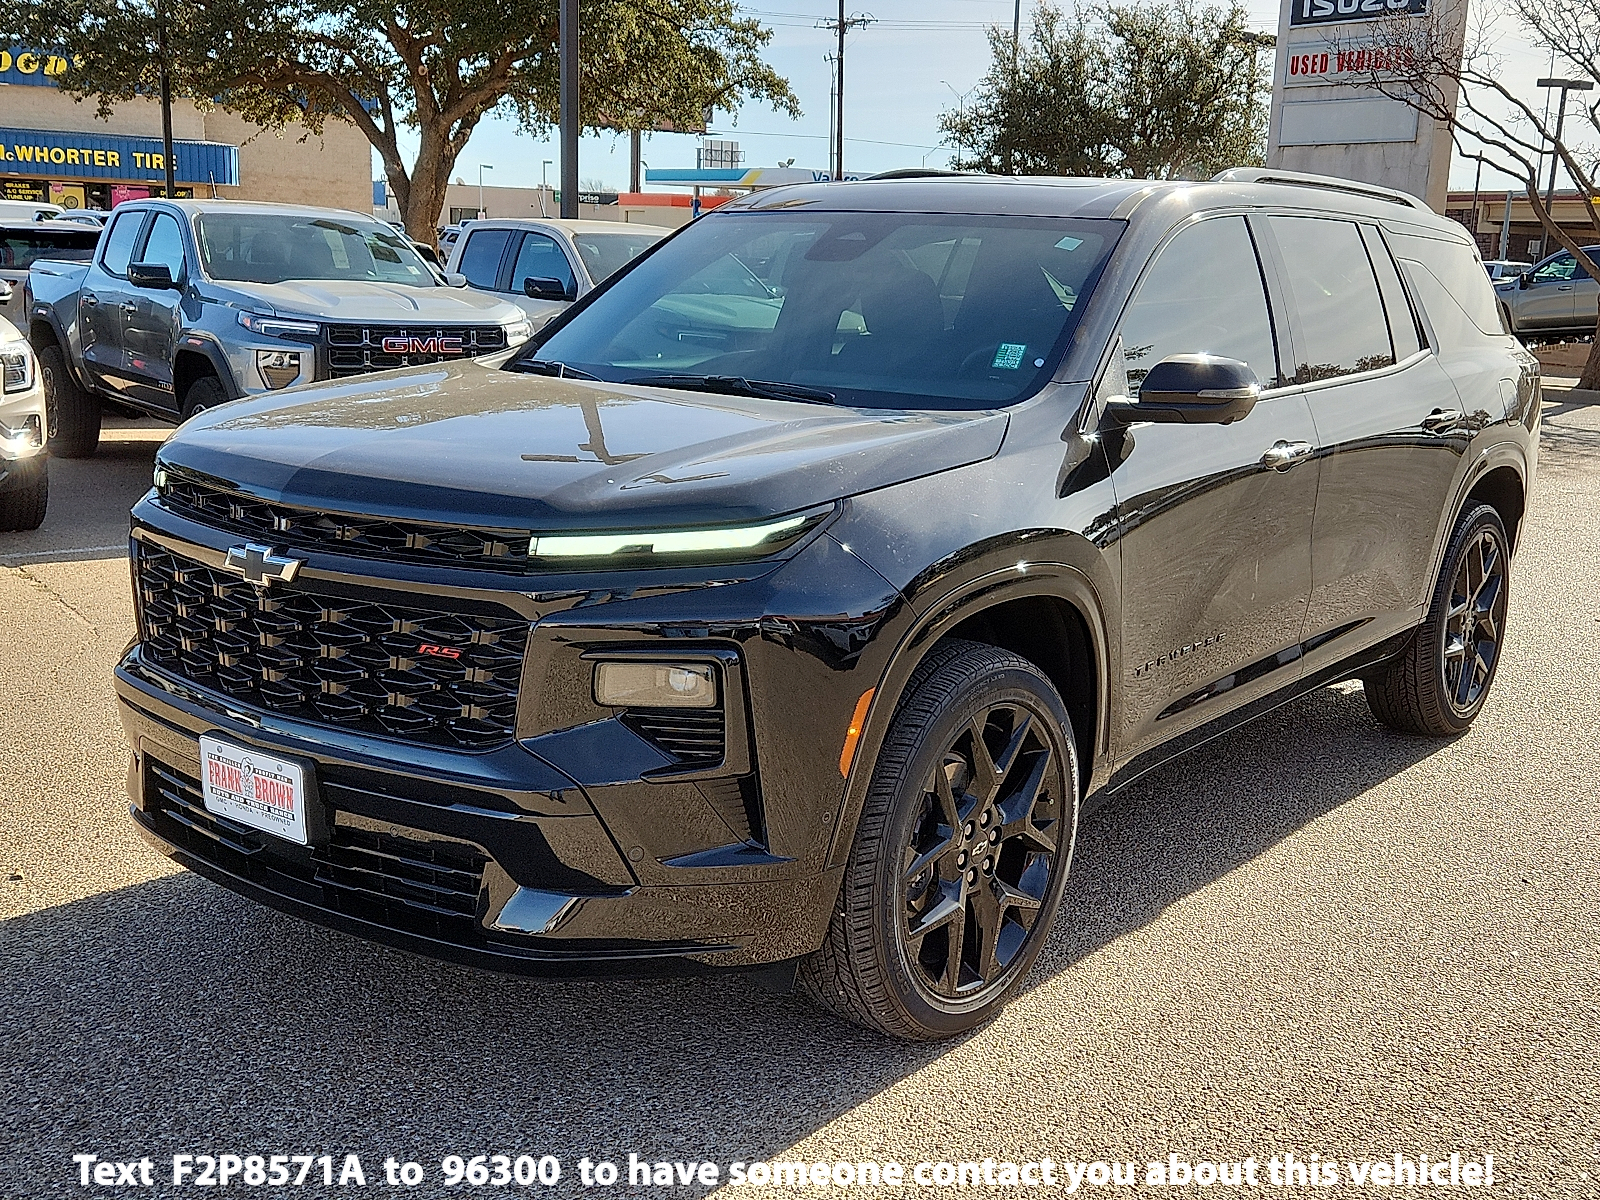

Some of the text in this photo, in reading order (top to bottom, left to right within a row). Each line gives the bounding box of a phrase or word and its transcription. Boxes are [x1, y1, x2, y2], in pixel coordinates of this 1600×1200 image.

[1290, 53, 1329, 76] USED
[811, 171, 859, 182] Varo
[382, 337, 463, 353] GMC
[418, 643, 461, 660] RS
[208, 760, 294, 813] FRANK BROWN
